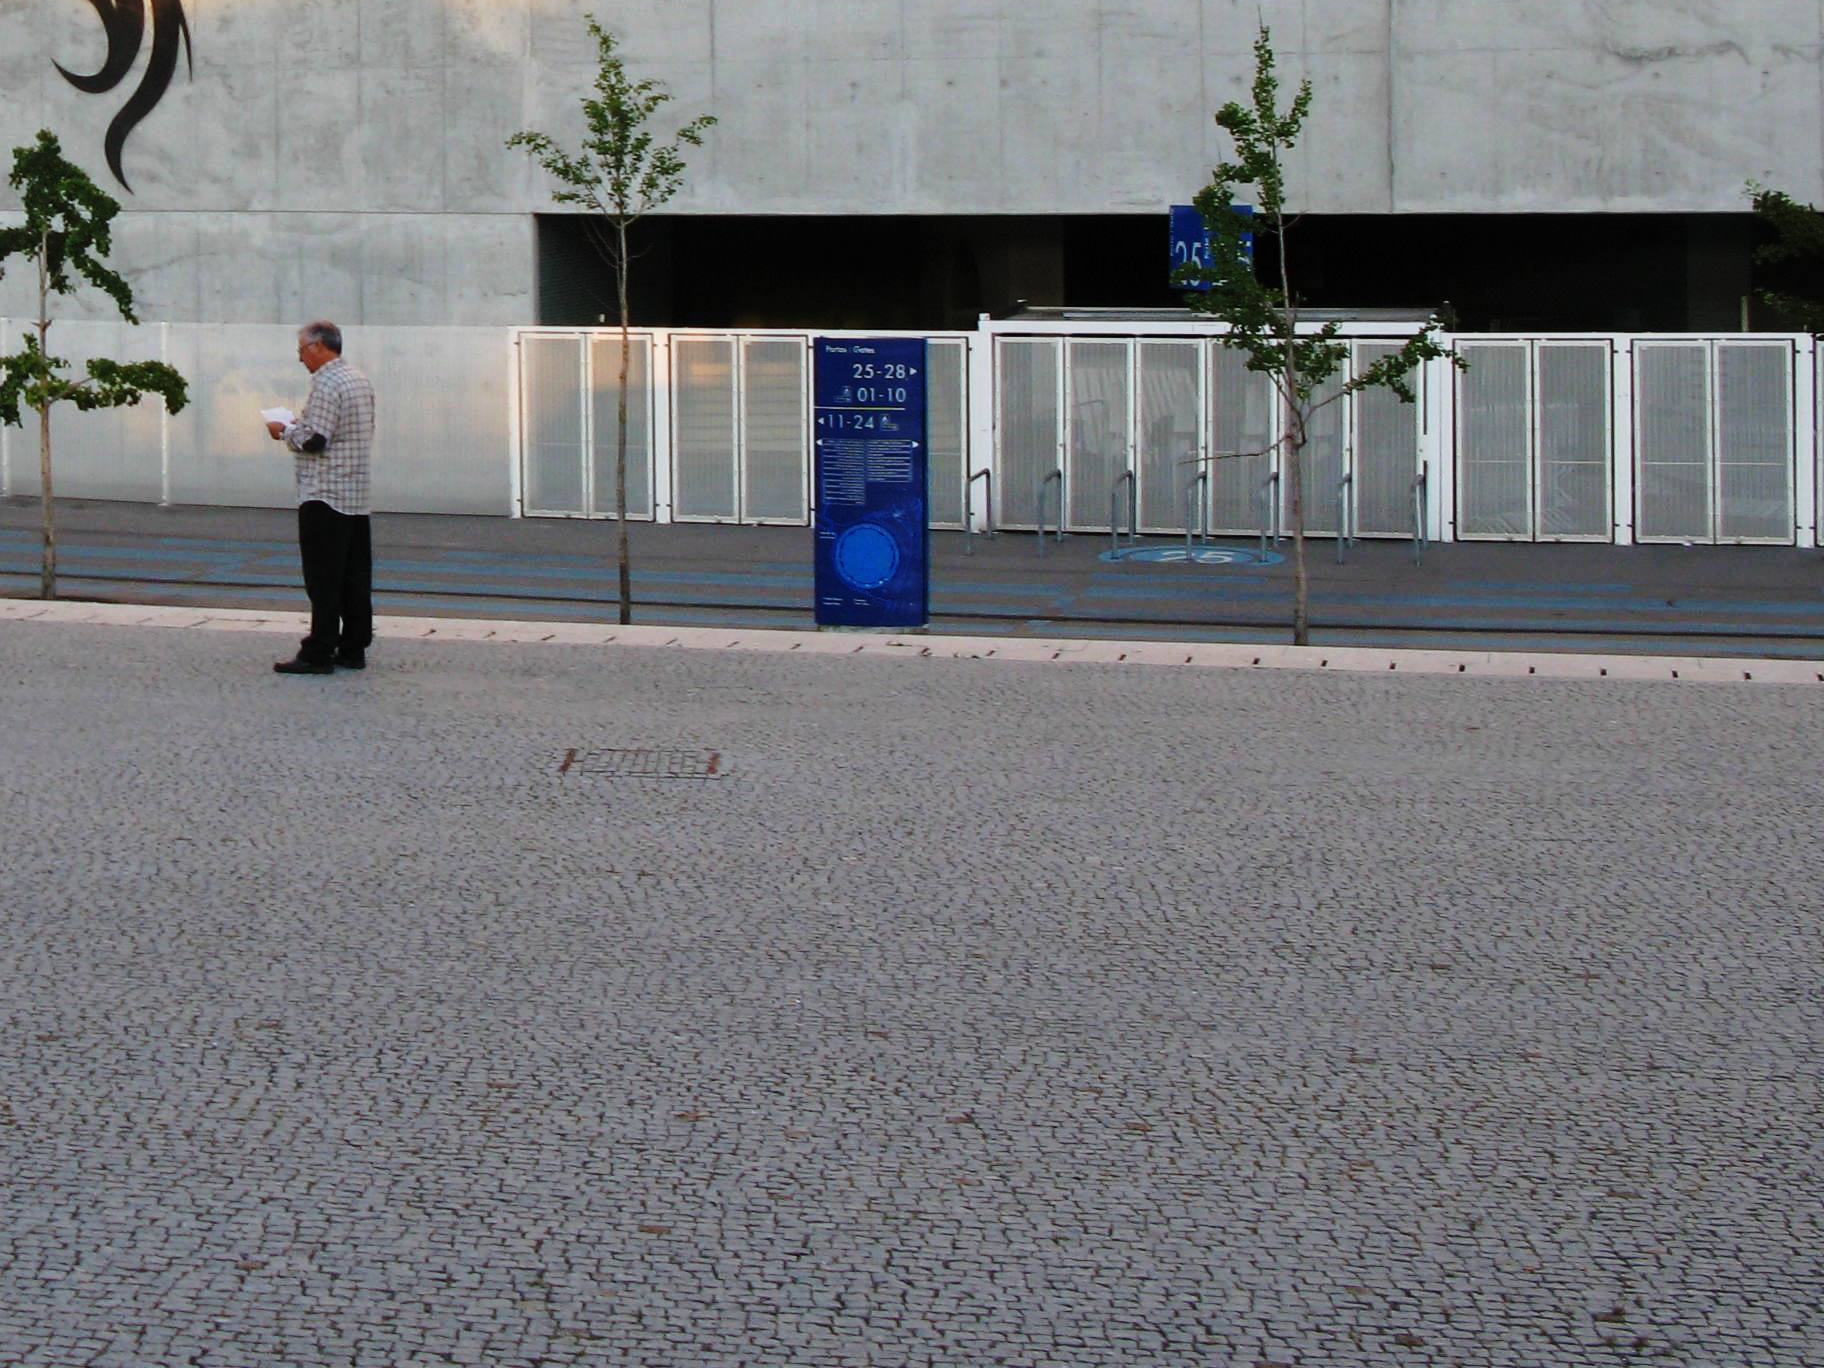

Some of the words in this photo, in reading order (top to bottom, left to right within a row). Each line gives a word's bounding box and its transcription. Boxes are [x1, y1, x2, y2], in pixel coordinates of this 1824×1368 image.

[852, 363, 906, 379] 25-28
[857, 387, 907, 403] 01-10
[828, 414, 875, 430] 11-24
